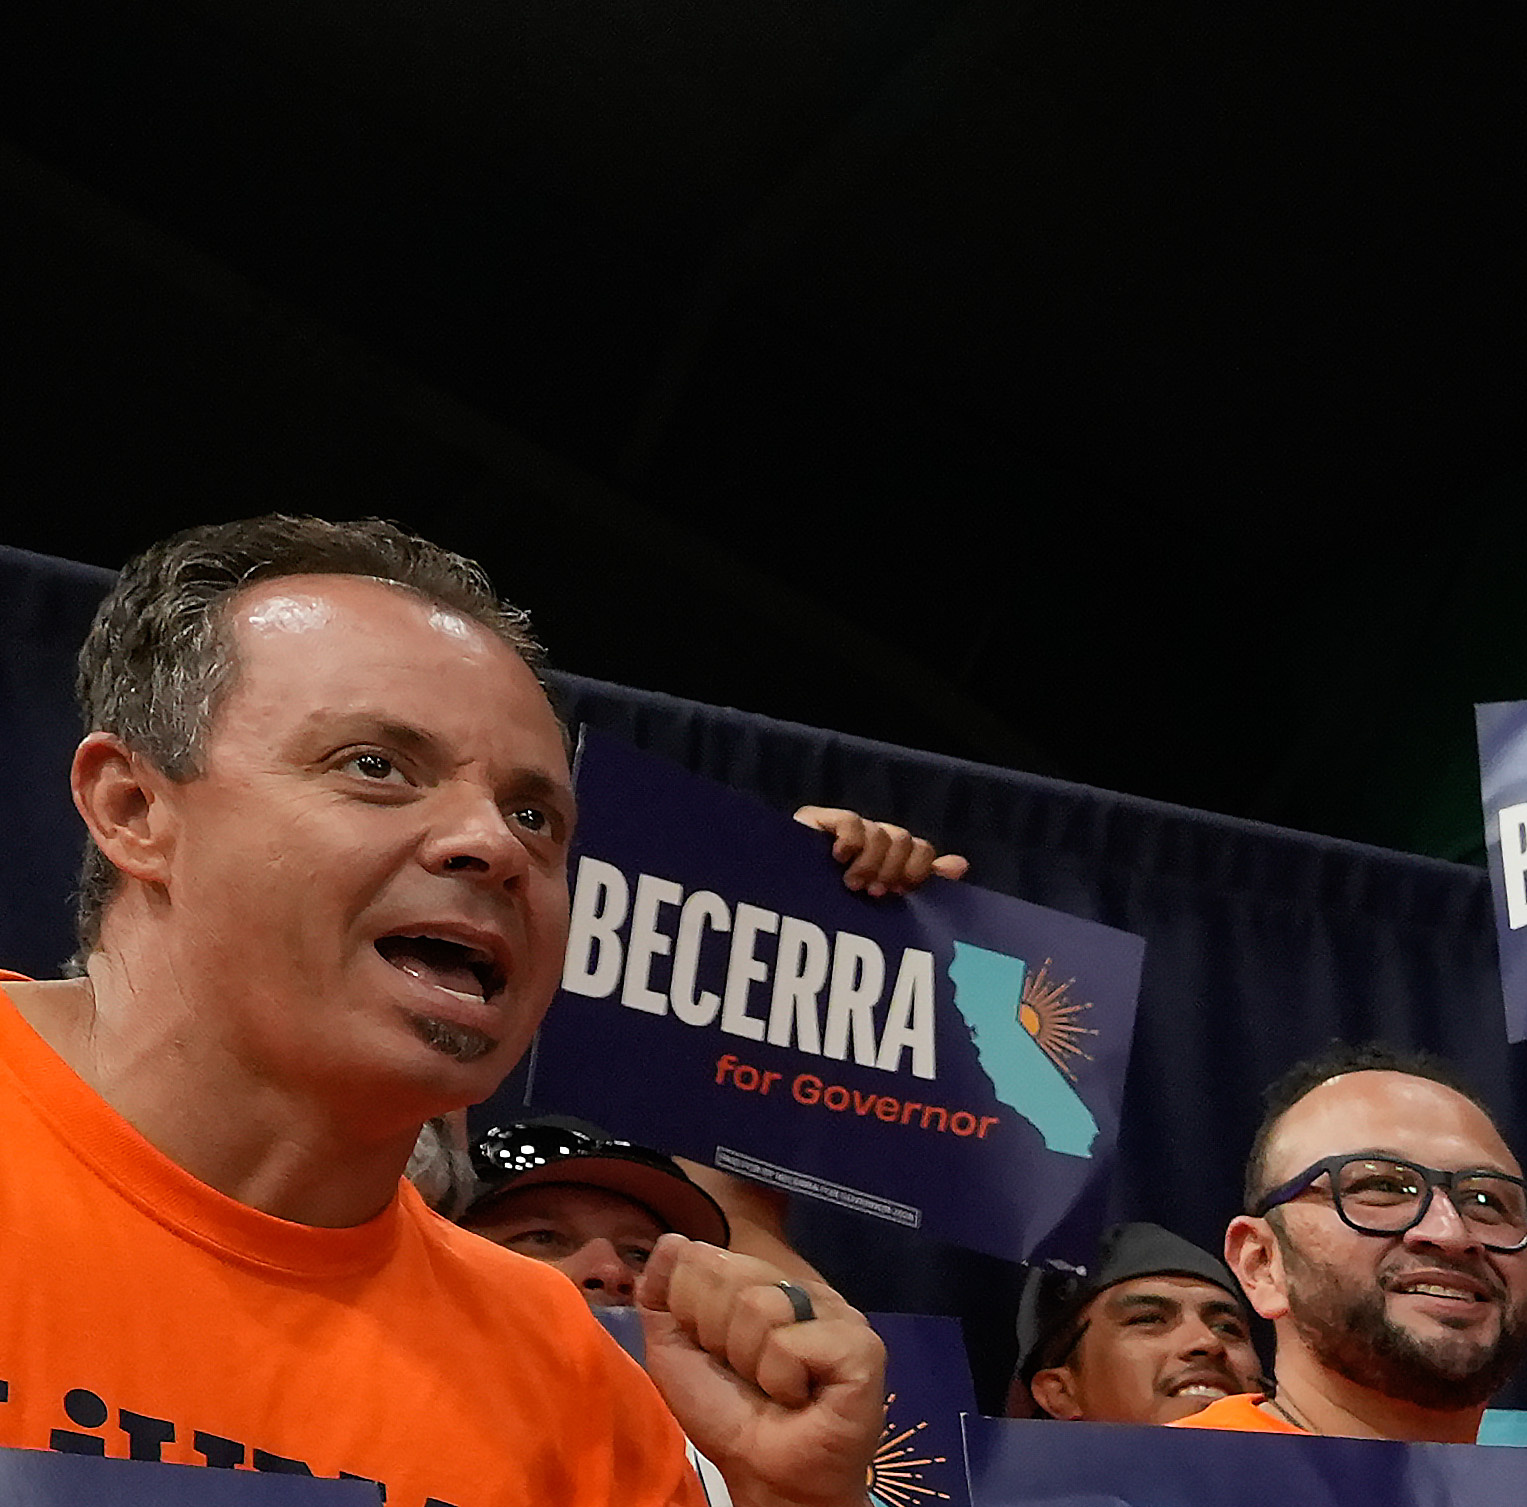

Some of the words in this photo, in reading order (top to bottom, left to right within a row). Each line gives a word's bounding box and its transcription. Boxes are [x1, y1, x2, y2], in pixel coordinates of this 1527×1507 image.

[562, 857, 935, 1079] BECERRA
[716, 1056, 781, 1093] for
[794, 1075, 998, 1138] Governor
